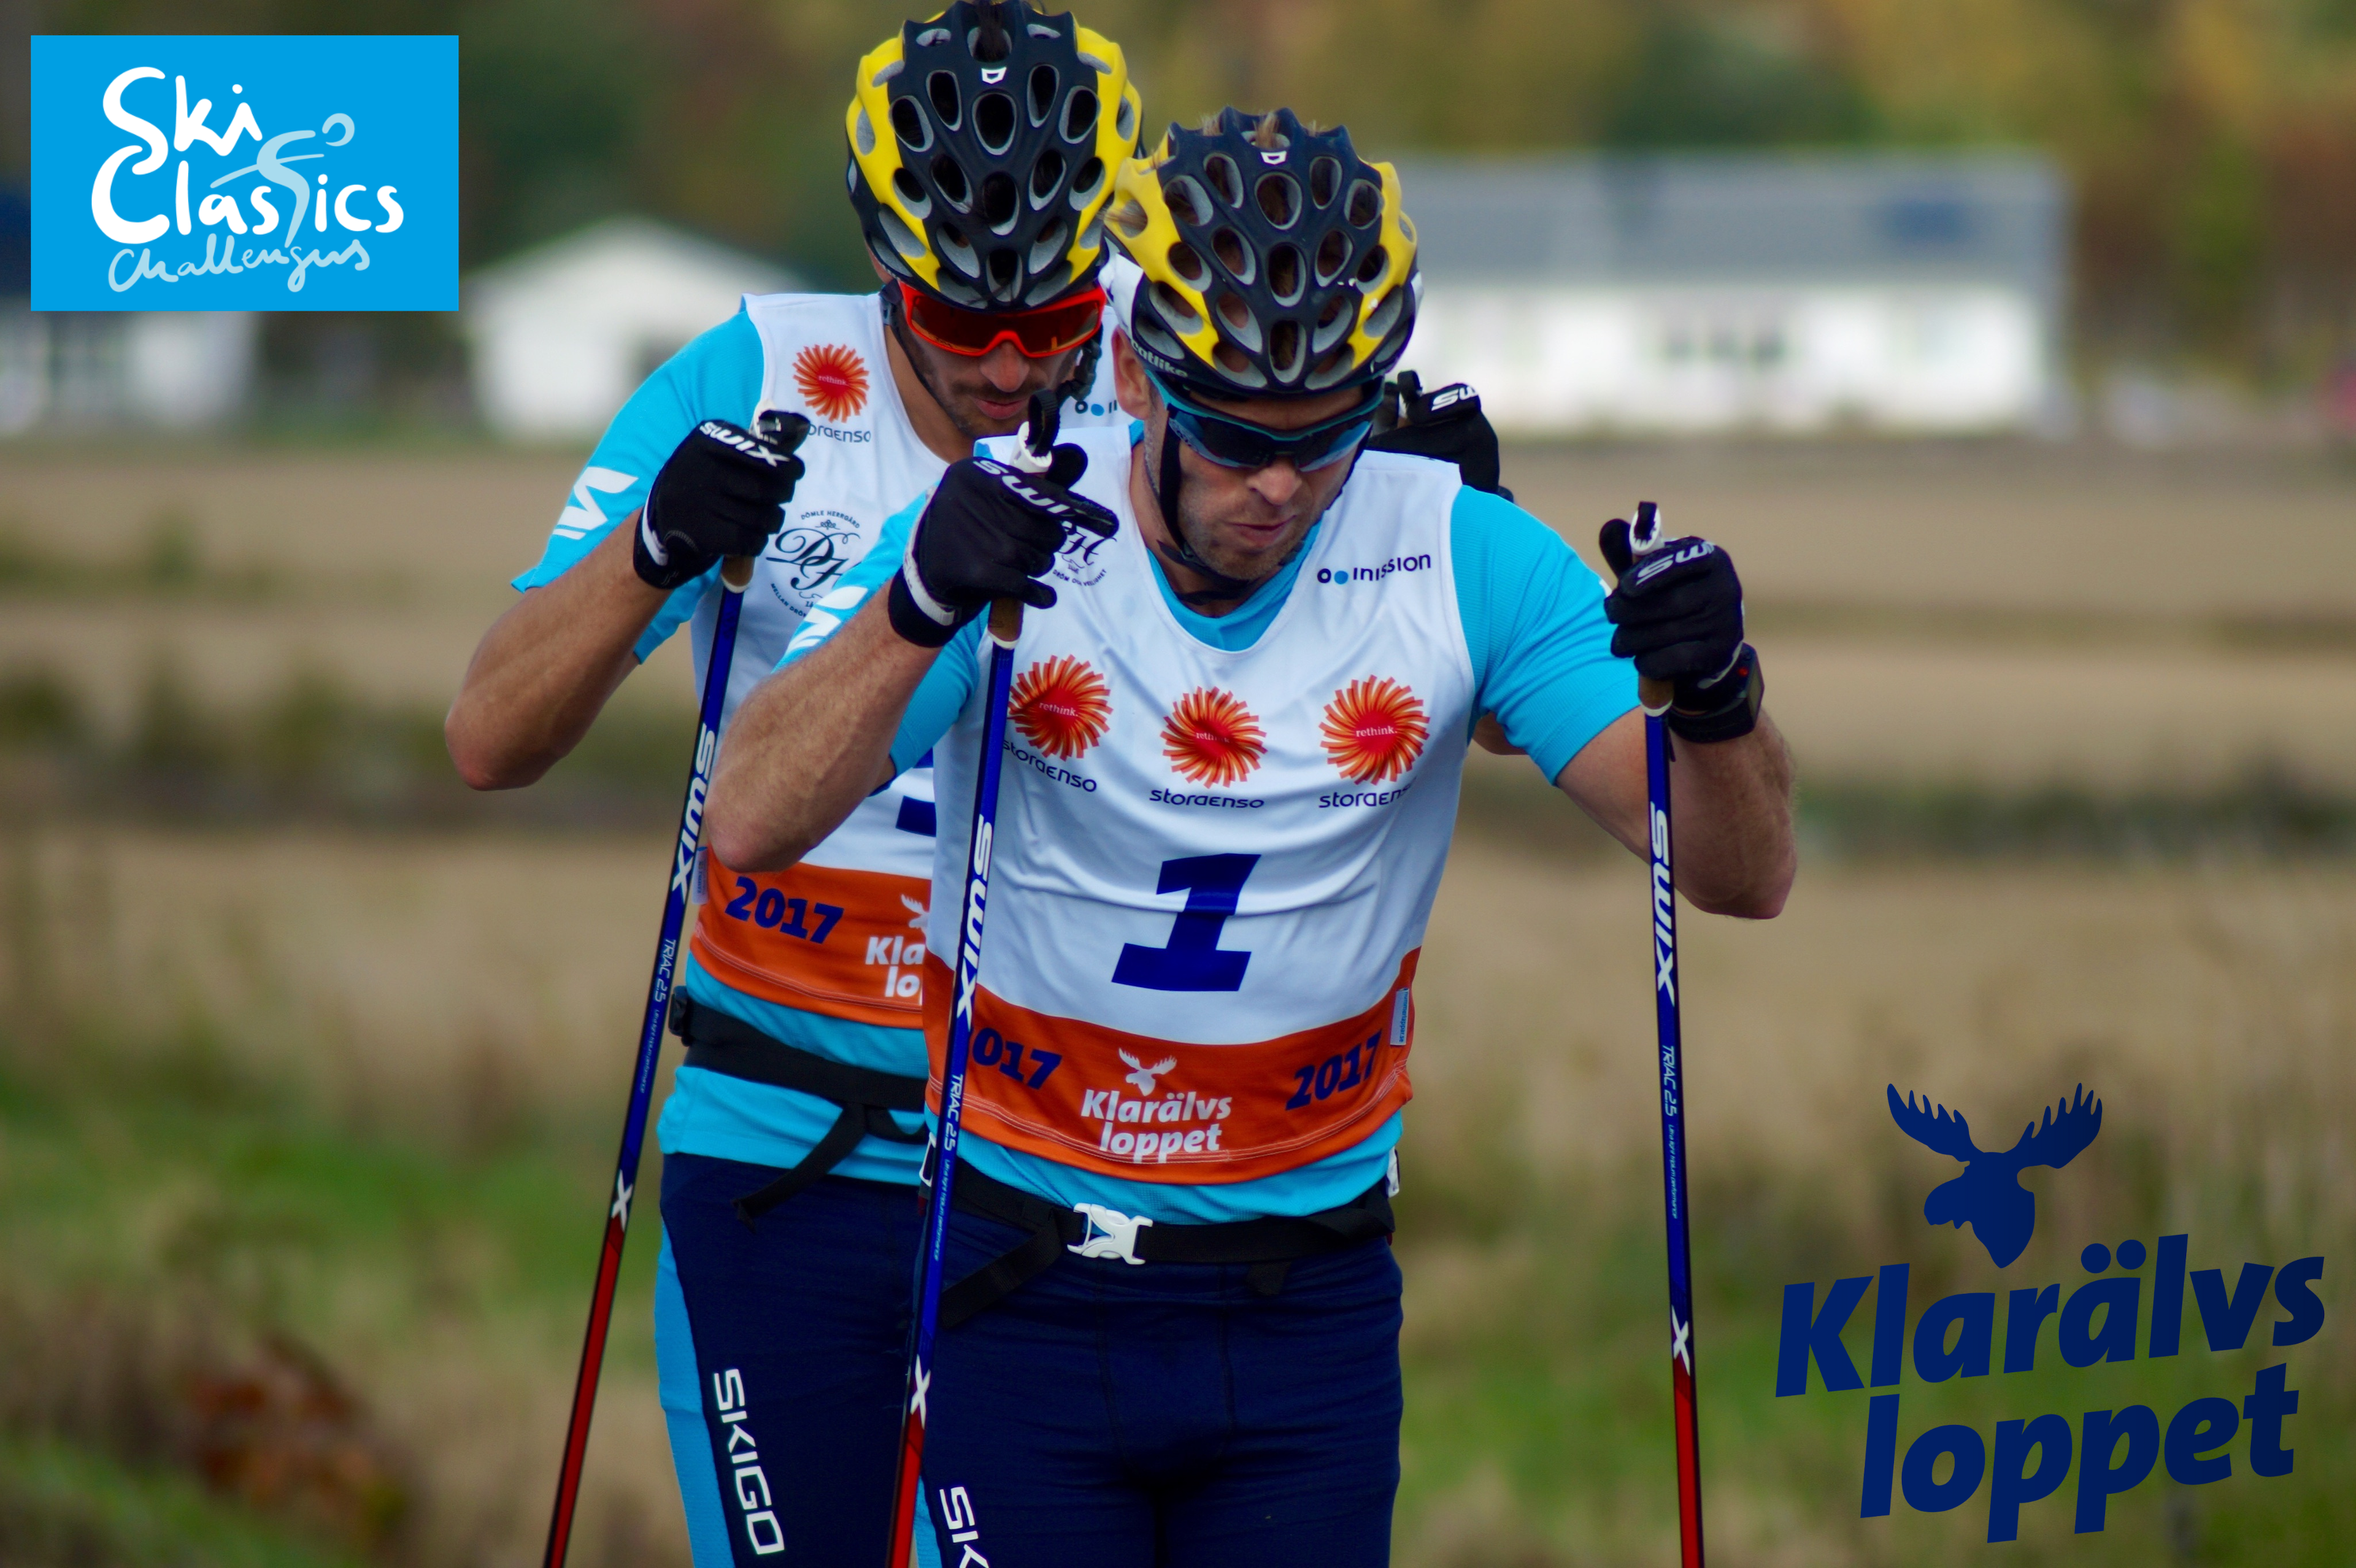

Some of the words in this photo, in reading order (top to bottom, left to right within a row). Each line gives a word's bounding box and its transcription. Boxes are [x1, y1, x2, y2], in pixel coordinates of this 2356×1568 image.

[808, 423, 871, 443] oraenso
[973, 461, 1070, 514] SWI
[801, 510, 824, 520] DÖMLE
[725, 877, 844, 944] 2017
[1111, 853, 1262, 992] 1
[659, 938, 676, 979] TRIAC
[972, 1028, 1063, 1090] 017
[1285, 1029, 1382, 1111] 2017
[1662, 1045, 1676, 1090] TRIAC
[947, 1074, 963, 1122] TRIAC
[1080, 1089, 1232, 1123] Klarälvs
[1099, 1121, 1222, 1164] loppet
[714, 1368, 785, 1555] SKIGO
